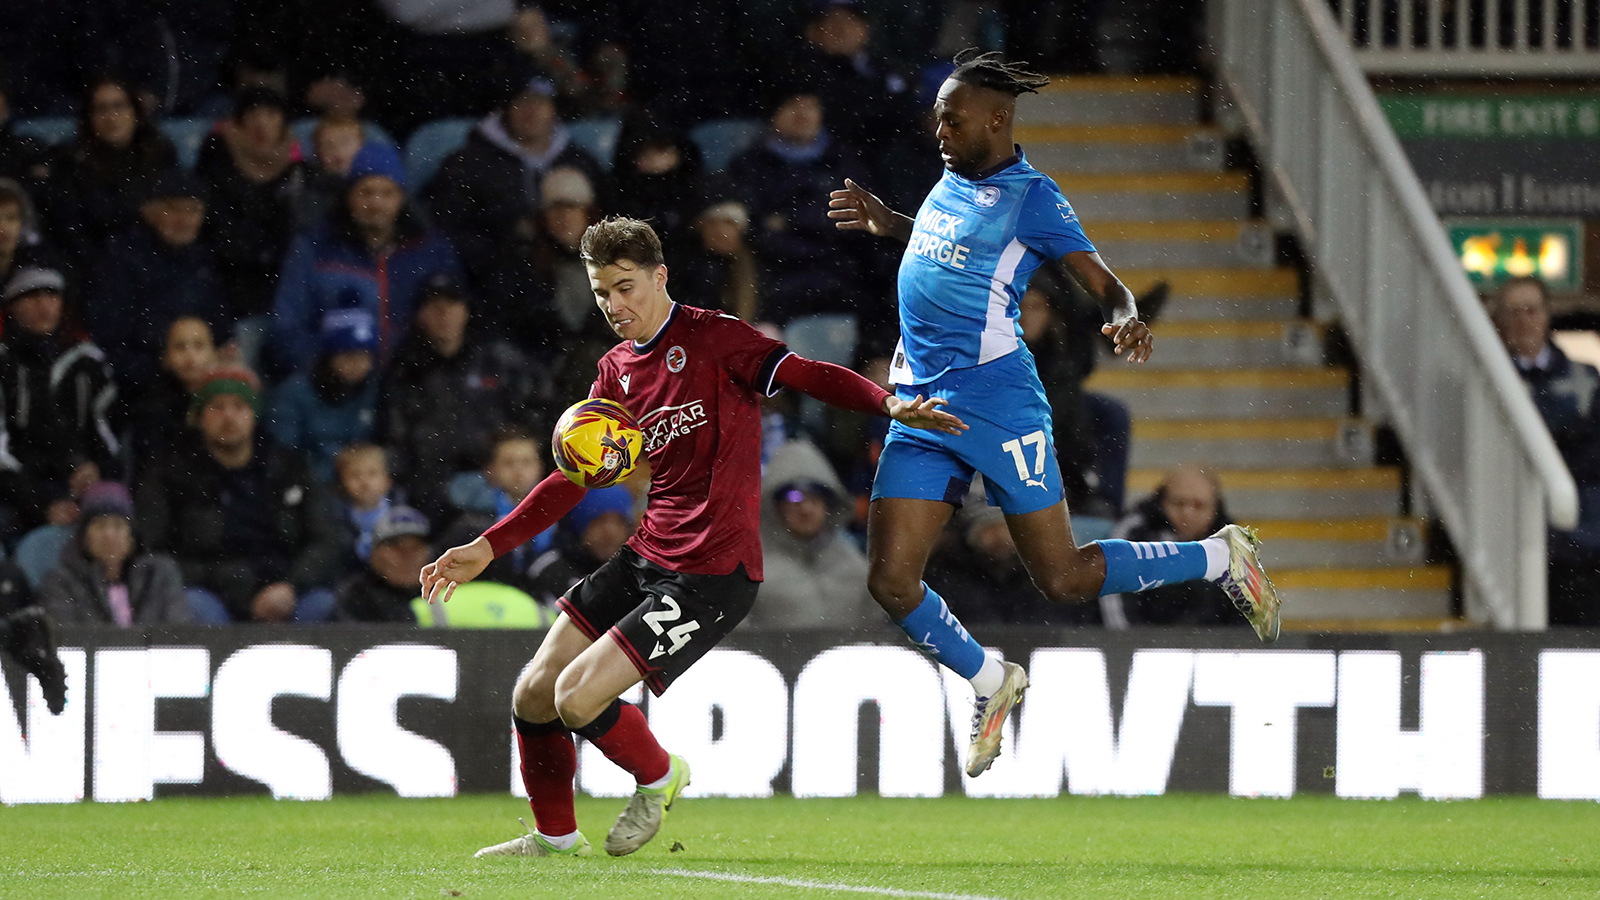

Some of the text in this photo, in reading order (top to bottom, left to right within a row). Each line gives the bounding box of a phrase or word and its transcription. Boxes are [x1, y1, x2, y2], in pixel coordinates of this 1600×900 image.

[1500, 101, 1568, 135] EXIT
[917, 208, 965, 240] MICK
[908, 230, 971, 270] EORGE
[1001, 430, 1046, 481] 17
[642, 594, 701, 656] 24
